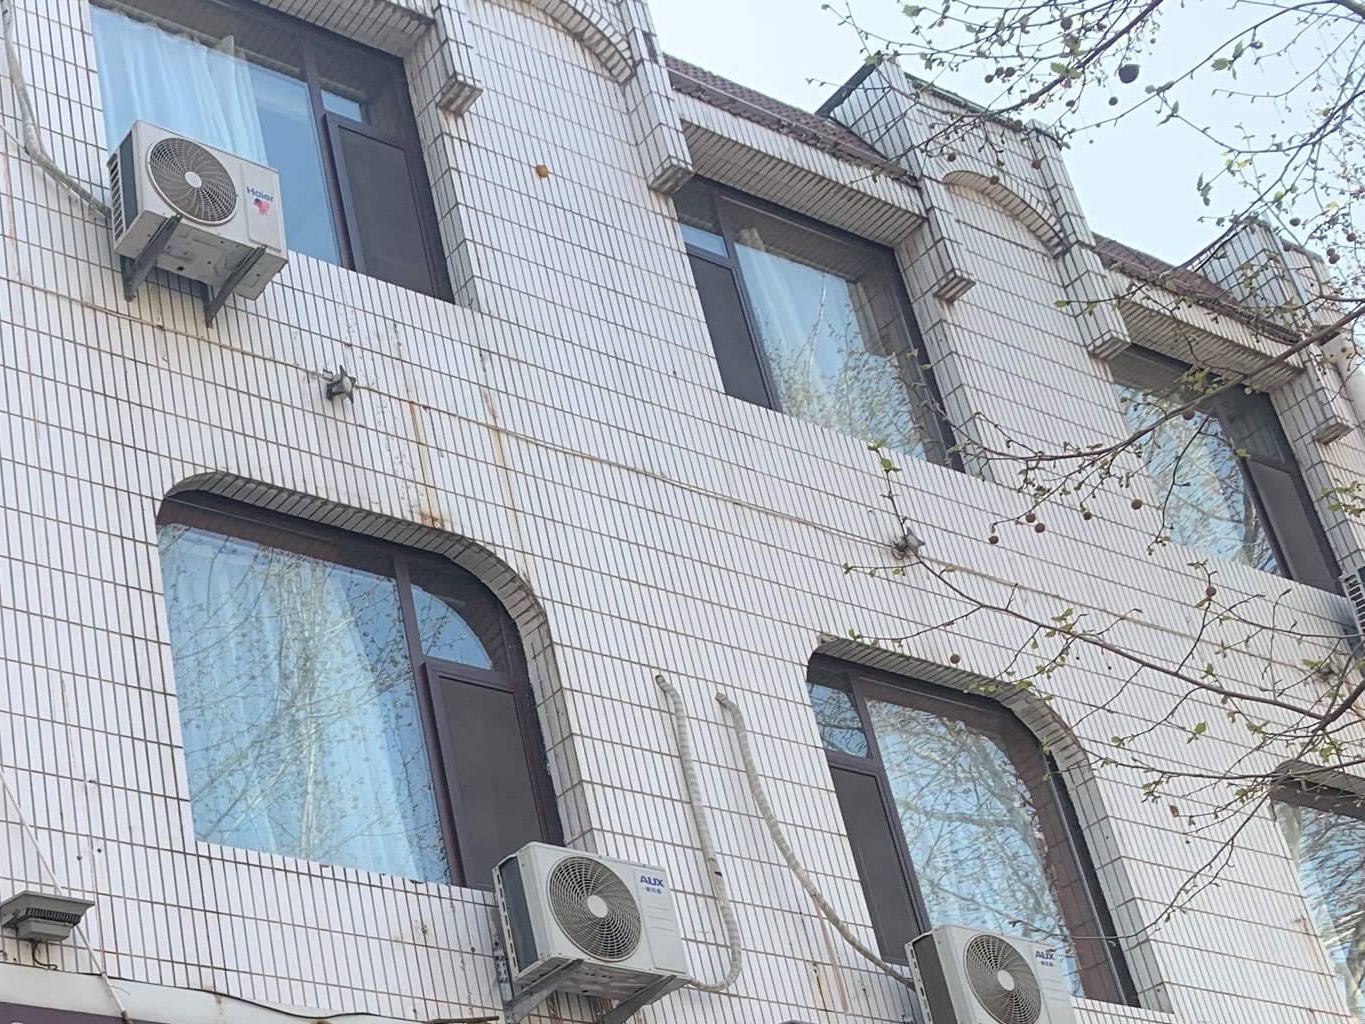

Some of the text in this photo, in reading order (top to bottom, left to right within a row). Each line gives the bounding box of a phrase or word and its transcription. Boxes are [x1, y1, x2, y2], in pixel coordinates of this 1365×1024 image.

[246, 186, 273, 202] Haier
[639, 875, 665, 888] AUX
[1035, 949, 1055, 961] AUX
